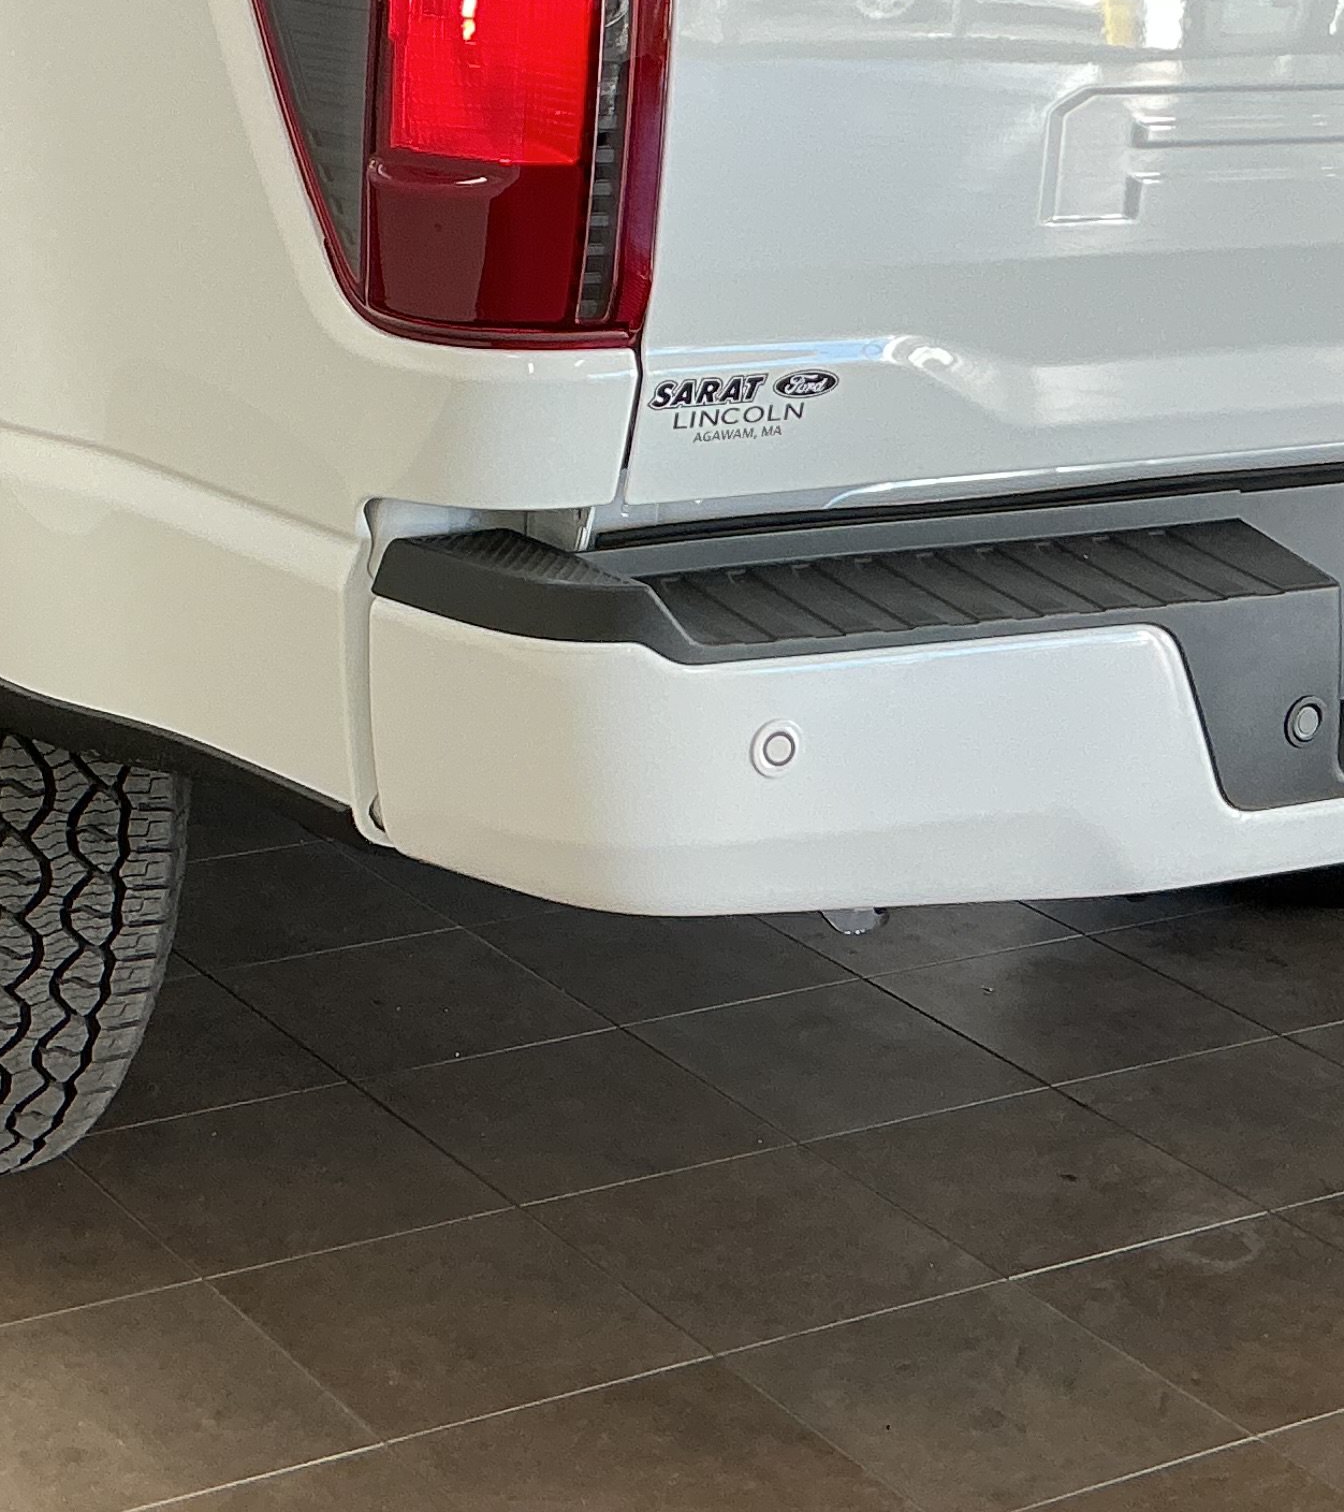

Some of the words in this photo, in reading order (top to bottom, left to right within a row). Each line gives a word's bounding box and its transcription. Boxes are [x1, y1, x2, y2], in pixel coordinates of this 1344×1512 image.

[648, 373, 768, 409] SARAT
[783, 373, 829, 395] Ford
[674, 403, 805, 430] LINCOLN
[692, 430, 759, 444] AGAWAM,
[761, 426, 783, 437] MA
